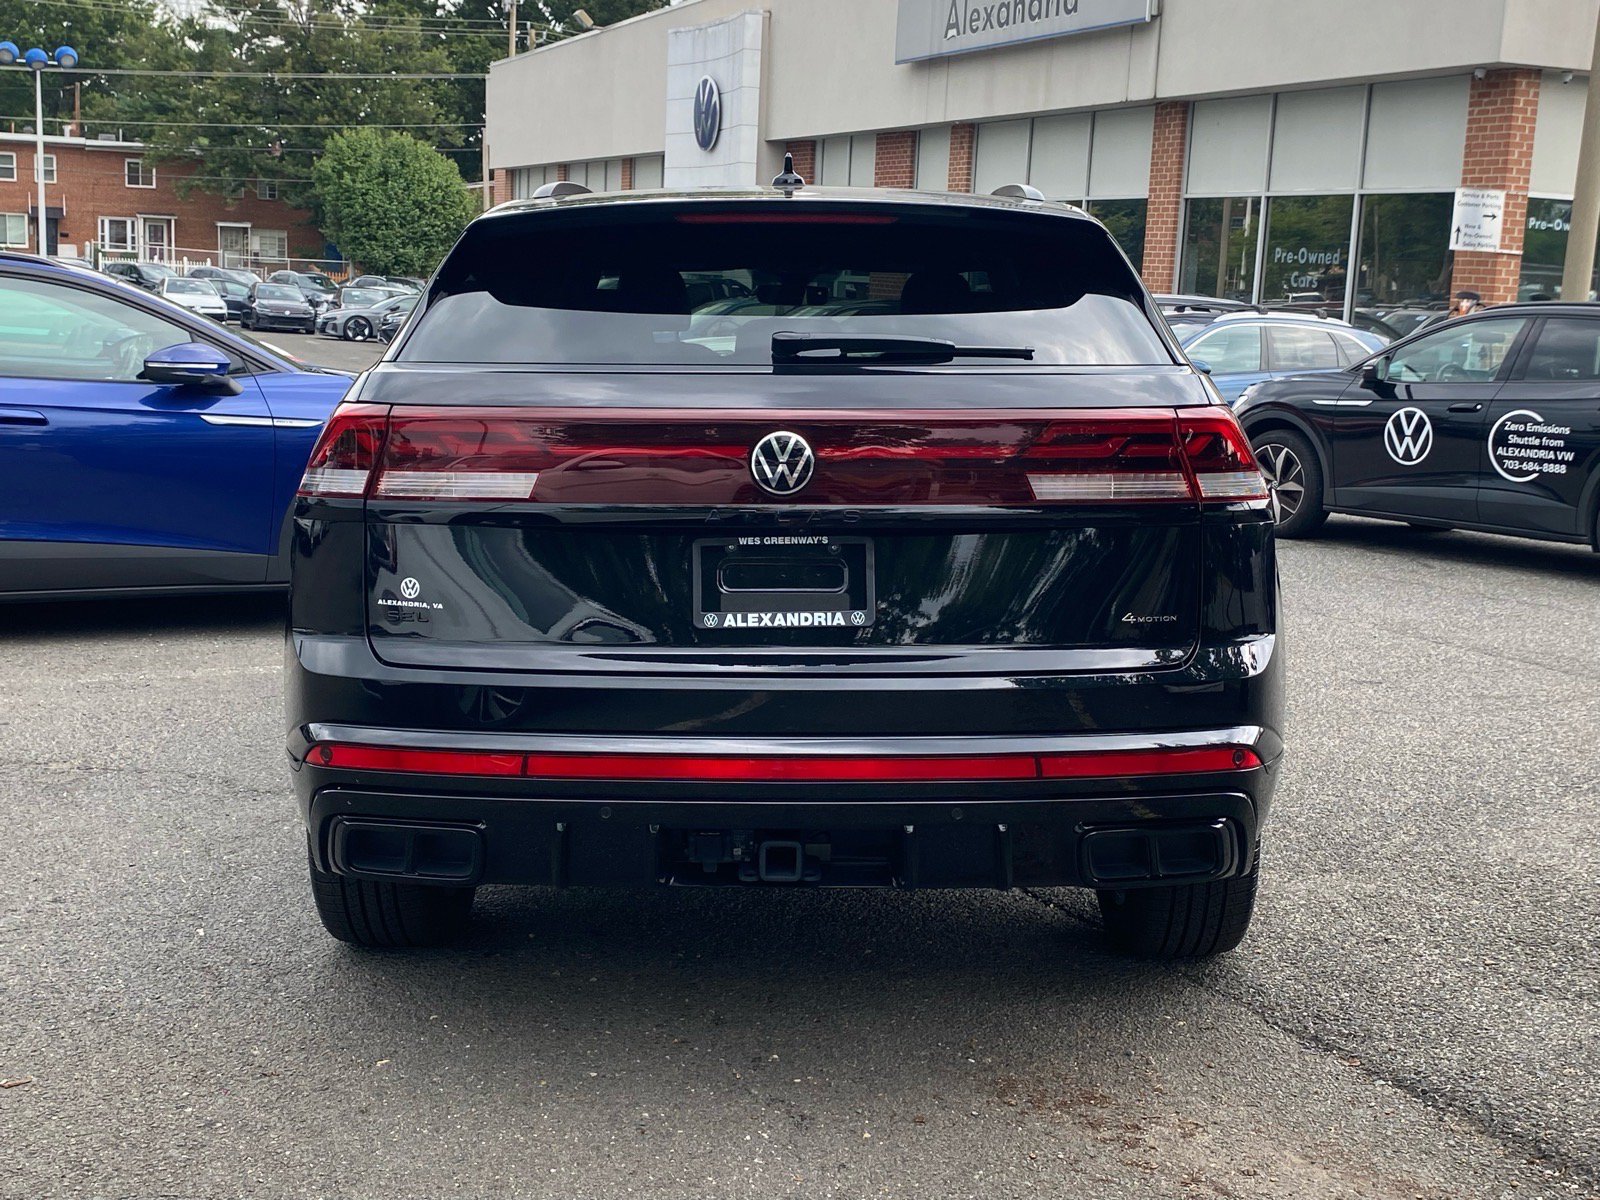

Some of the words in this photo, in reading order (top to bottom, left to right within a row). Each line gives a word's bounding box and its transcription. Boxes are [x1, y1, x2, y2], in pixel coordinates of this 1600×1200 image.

[1528, 217, 1570, 230] Pre-Ow
[1274, 248, 1340, 264] Pre-Owned
[1290, 272, 1318, 288] Cars
[1504, 421, 1525, 432] Zero
[1526, 422, 1570, 434] Emissions
[1508, 434, 1540, 446] Shuttle
[1542, 436, 1564, 447] from
[1496, 446, 1555, 460] ALEXANDRIA
[1556, 451, 1574, 461] VW
[1503, 460, 1566, 474] 703-684-8888
[704, 509, 862, 523] ATLAS
[738, 537, 760, 545] WES
[763, 536, 828, 545] GREENWAY'S
[378, 599, 430, 609] ALEXANDRIA,
[388, 610, 429, 622] SEL
[723, 612, 846, 627] ALEXANDRIA
[1122, 612, 1178, 624] 4MOTION
